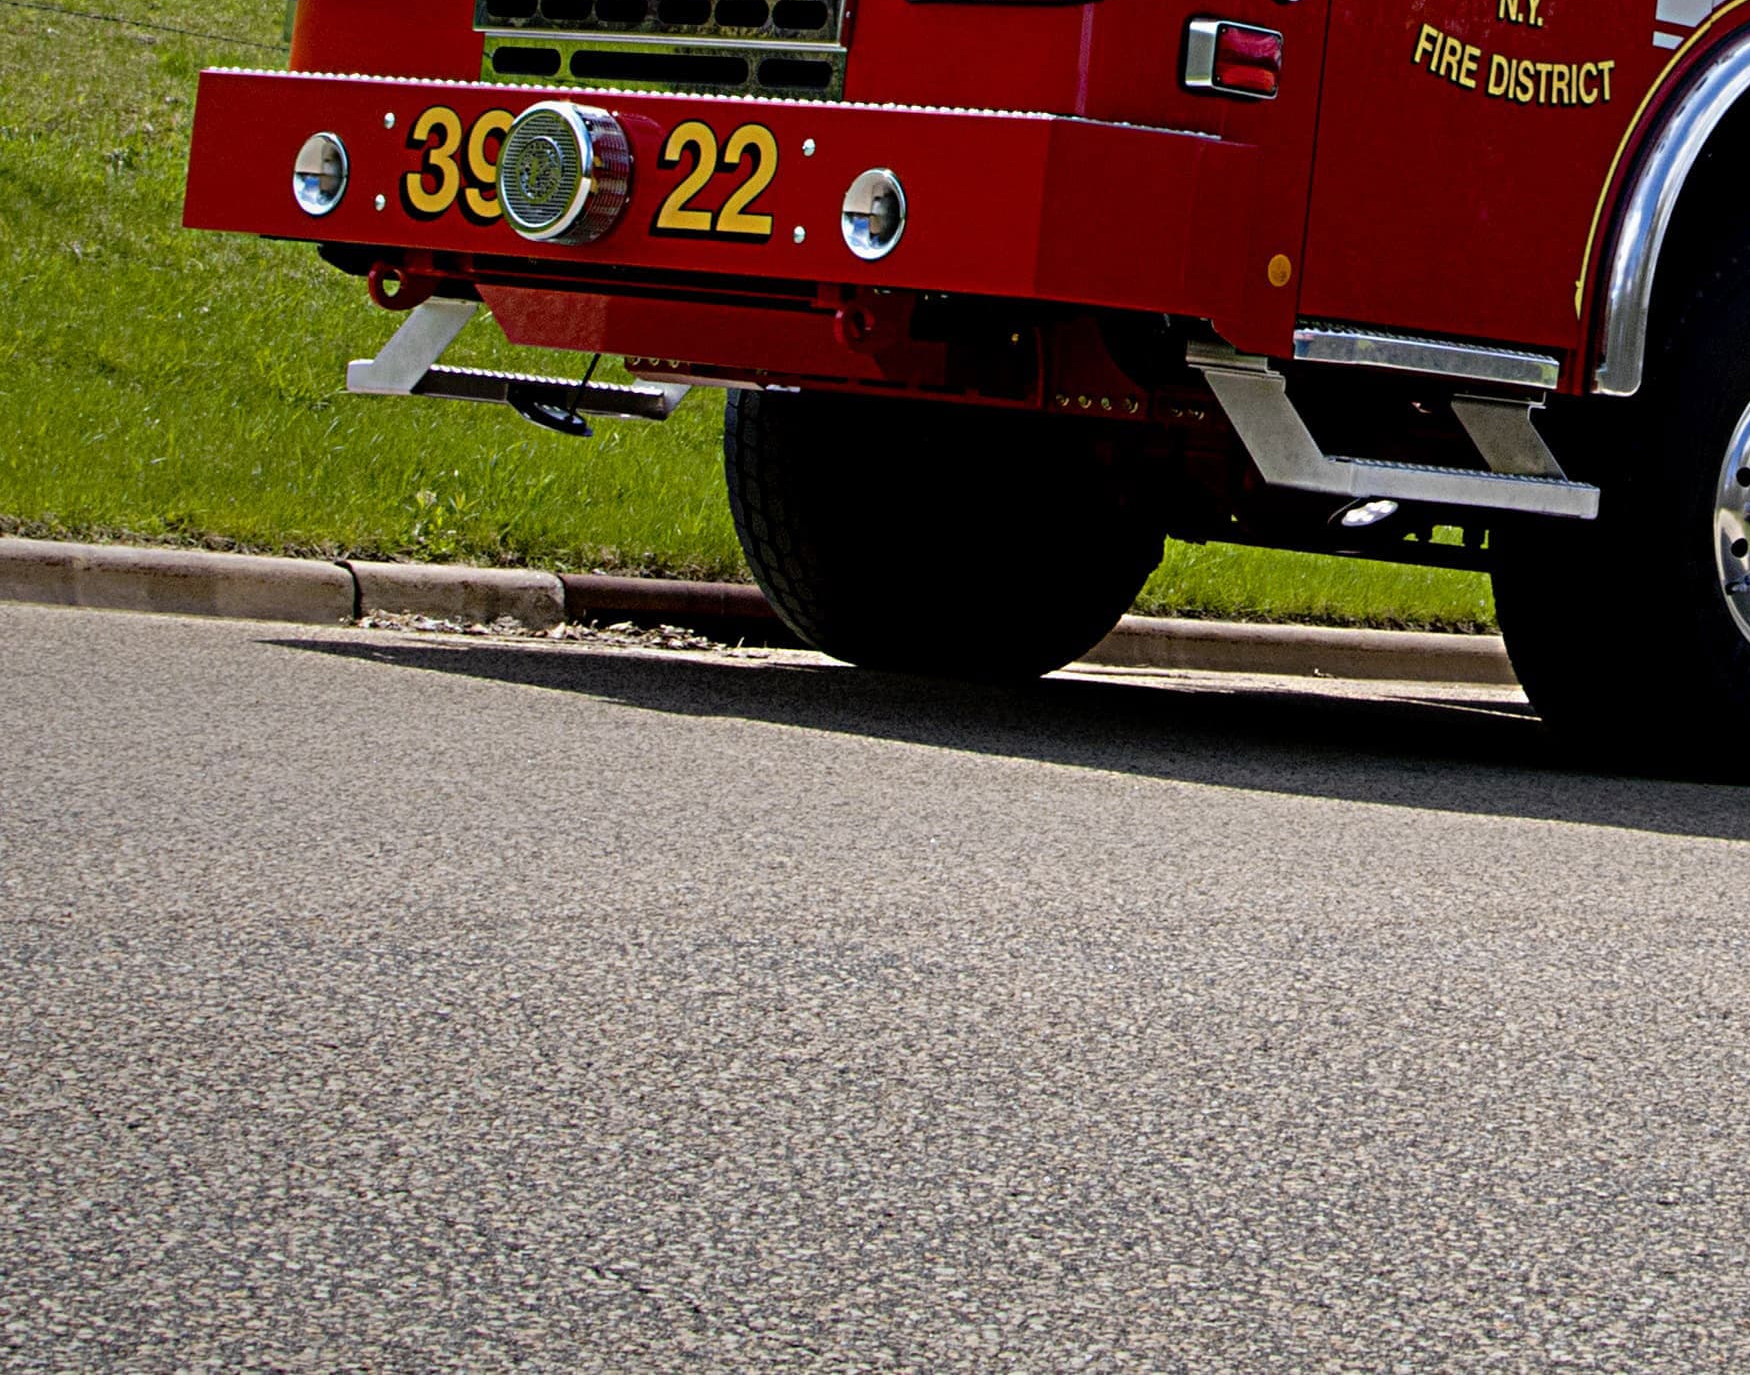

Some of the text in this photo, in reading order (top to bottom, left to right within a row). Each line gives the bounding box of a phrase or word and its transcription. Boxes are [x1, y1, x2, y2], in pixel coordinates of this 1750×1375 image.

[1413, 23, 1615, 105] FIRE DISTRICT
[655, 121, 778, 235] 22
